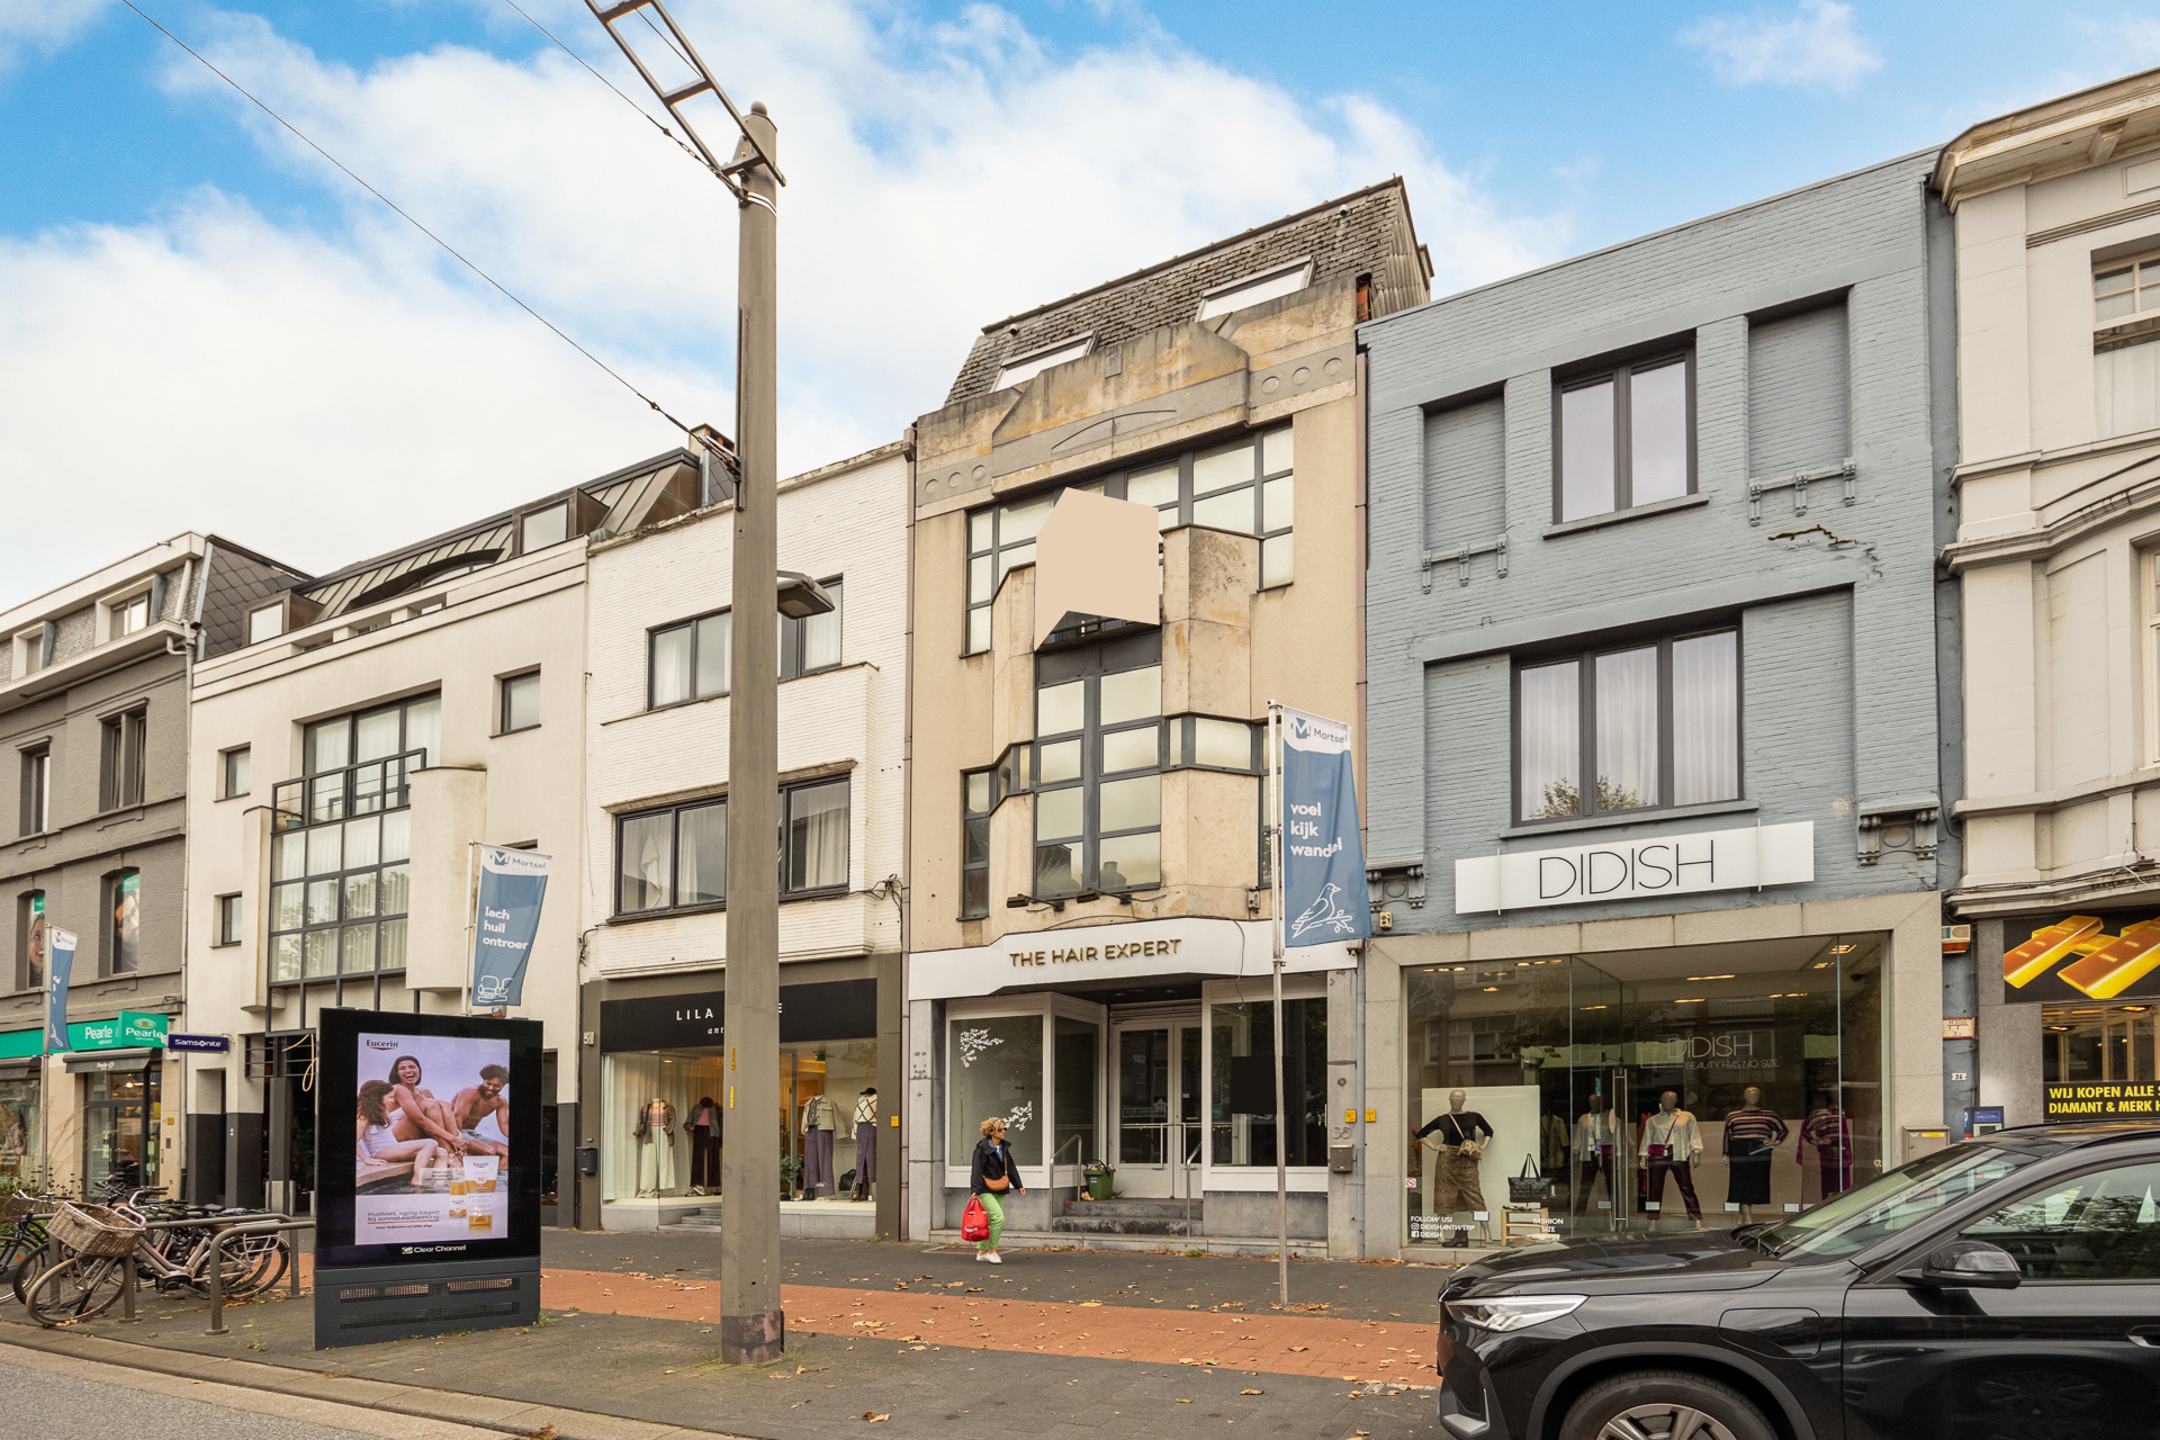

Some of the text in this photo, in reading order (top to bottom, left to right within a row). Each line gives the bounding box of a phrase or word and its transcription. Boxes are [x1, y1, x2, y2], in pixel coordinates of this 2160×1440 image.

[1290, 802, 1322, 817] voel
[1290, 820, 1319, 840] kijk
[512, 858, 546, 869] Mortsel
[1539, 839, 1714, 899] DIDISH
[485, 906, 510, 920] lach
[483, 920, 506, 933] huil
[482, 937, 529, 950] ontroer
[1009, 938, 1182, 967] THE HAIR EXPERT
[676, 1008, 714, 1021] LILA
[85, 1025, 113, 1040] Pearle
[126, 1027, 163, 1039] Pearle
[174, 1039, 222, 1047] Samsonite
[366, 1039, 399, 1048] Eucerin
[1667, 1035, 1753, 1059] DIDISH
[1685, 1060, 1780, 1070] BEAUTY HAS NO SIZE
[2049, 1087, 2073, 1099] WIJ
[2077, 1086, 2121, 1098] KOPEN
[2124, 1085, 2154, 1097] ALLE
[2049, 1101, 2103, 1114] DIAMANT
[2105, 1101, 2116, 1113] &
[2118, 1100, 2152, 1112] MERK
[1332, 1126, 1351, 1140] 38
[435, 1244, 466, 1252] Channel
